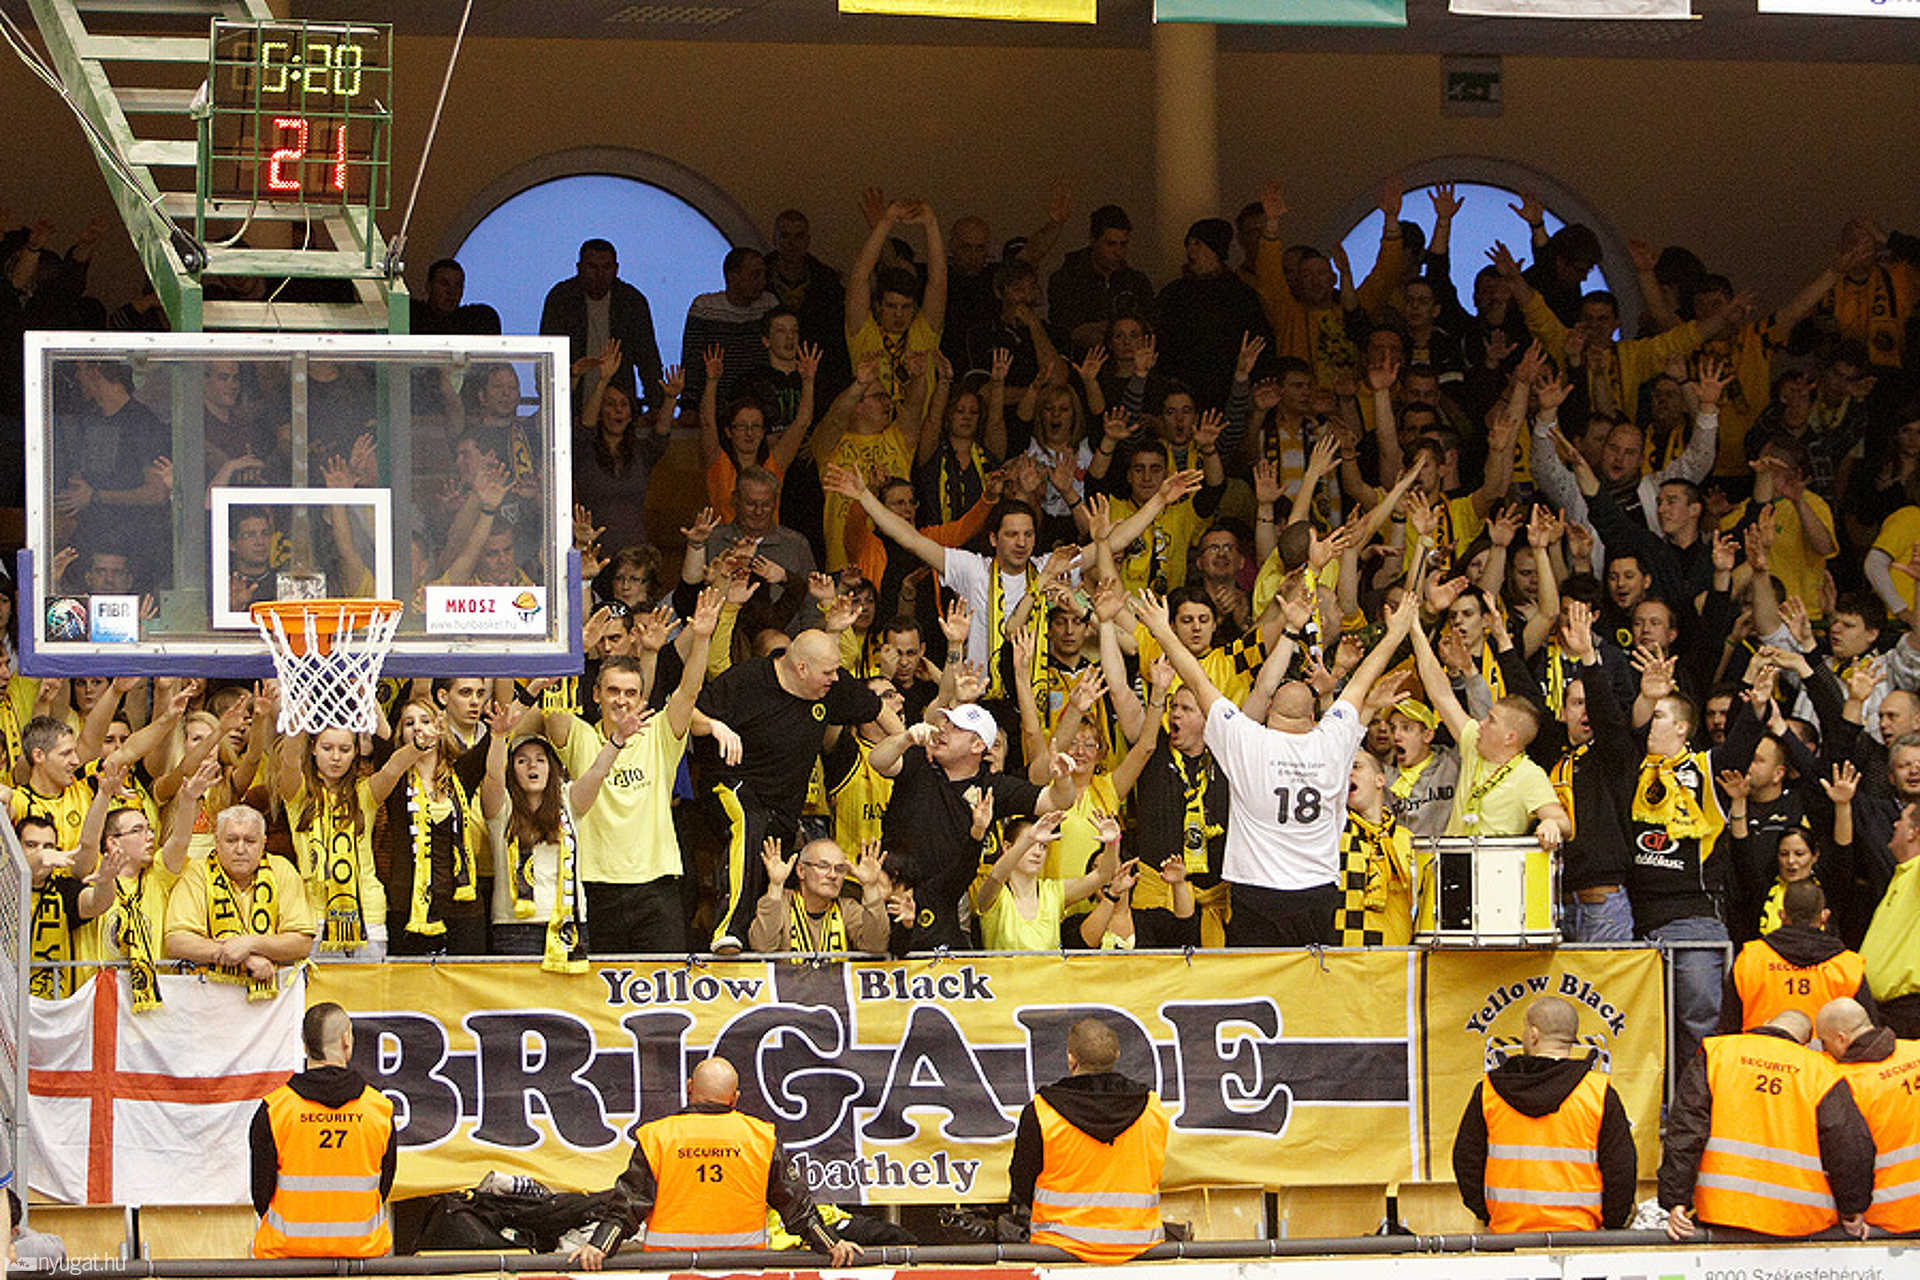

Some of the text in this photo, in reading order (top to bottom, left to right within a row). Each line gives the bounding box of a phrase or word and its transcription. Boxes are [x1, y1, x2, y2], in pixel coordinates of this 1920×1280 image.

[262, 42, 362, 96] 5:20
[268, 118, 346, 190] 21
[445, 599, 496, 613] MKOSZ
[1273, 786, 1322, 824] 18
[599, 966, 995, 1005] Yellow Black
[1785, 978, 1811, 995] 18
[1465, 972, 1626, 1037] Yellow Black
[1740, 1056, 1801, 1073] SECURITY
[350, 998, 1294, 1152] BRIGADE
[1755, 1074, 1783, 1095] 26
[300, 1112, 363, 1122] SECURITY
[319, 1129, 348, 1149] 27
[677, 1147, 741, 1158] SECURITY
[695, 1164, 723, 1182] 13
